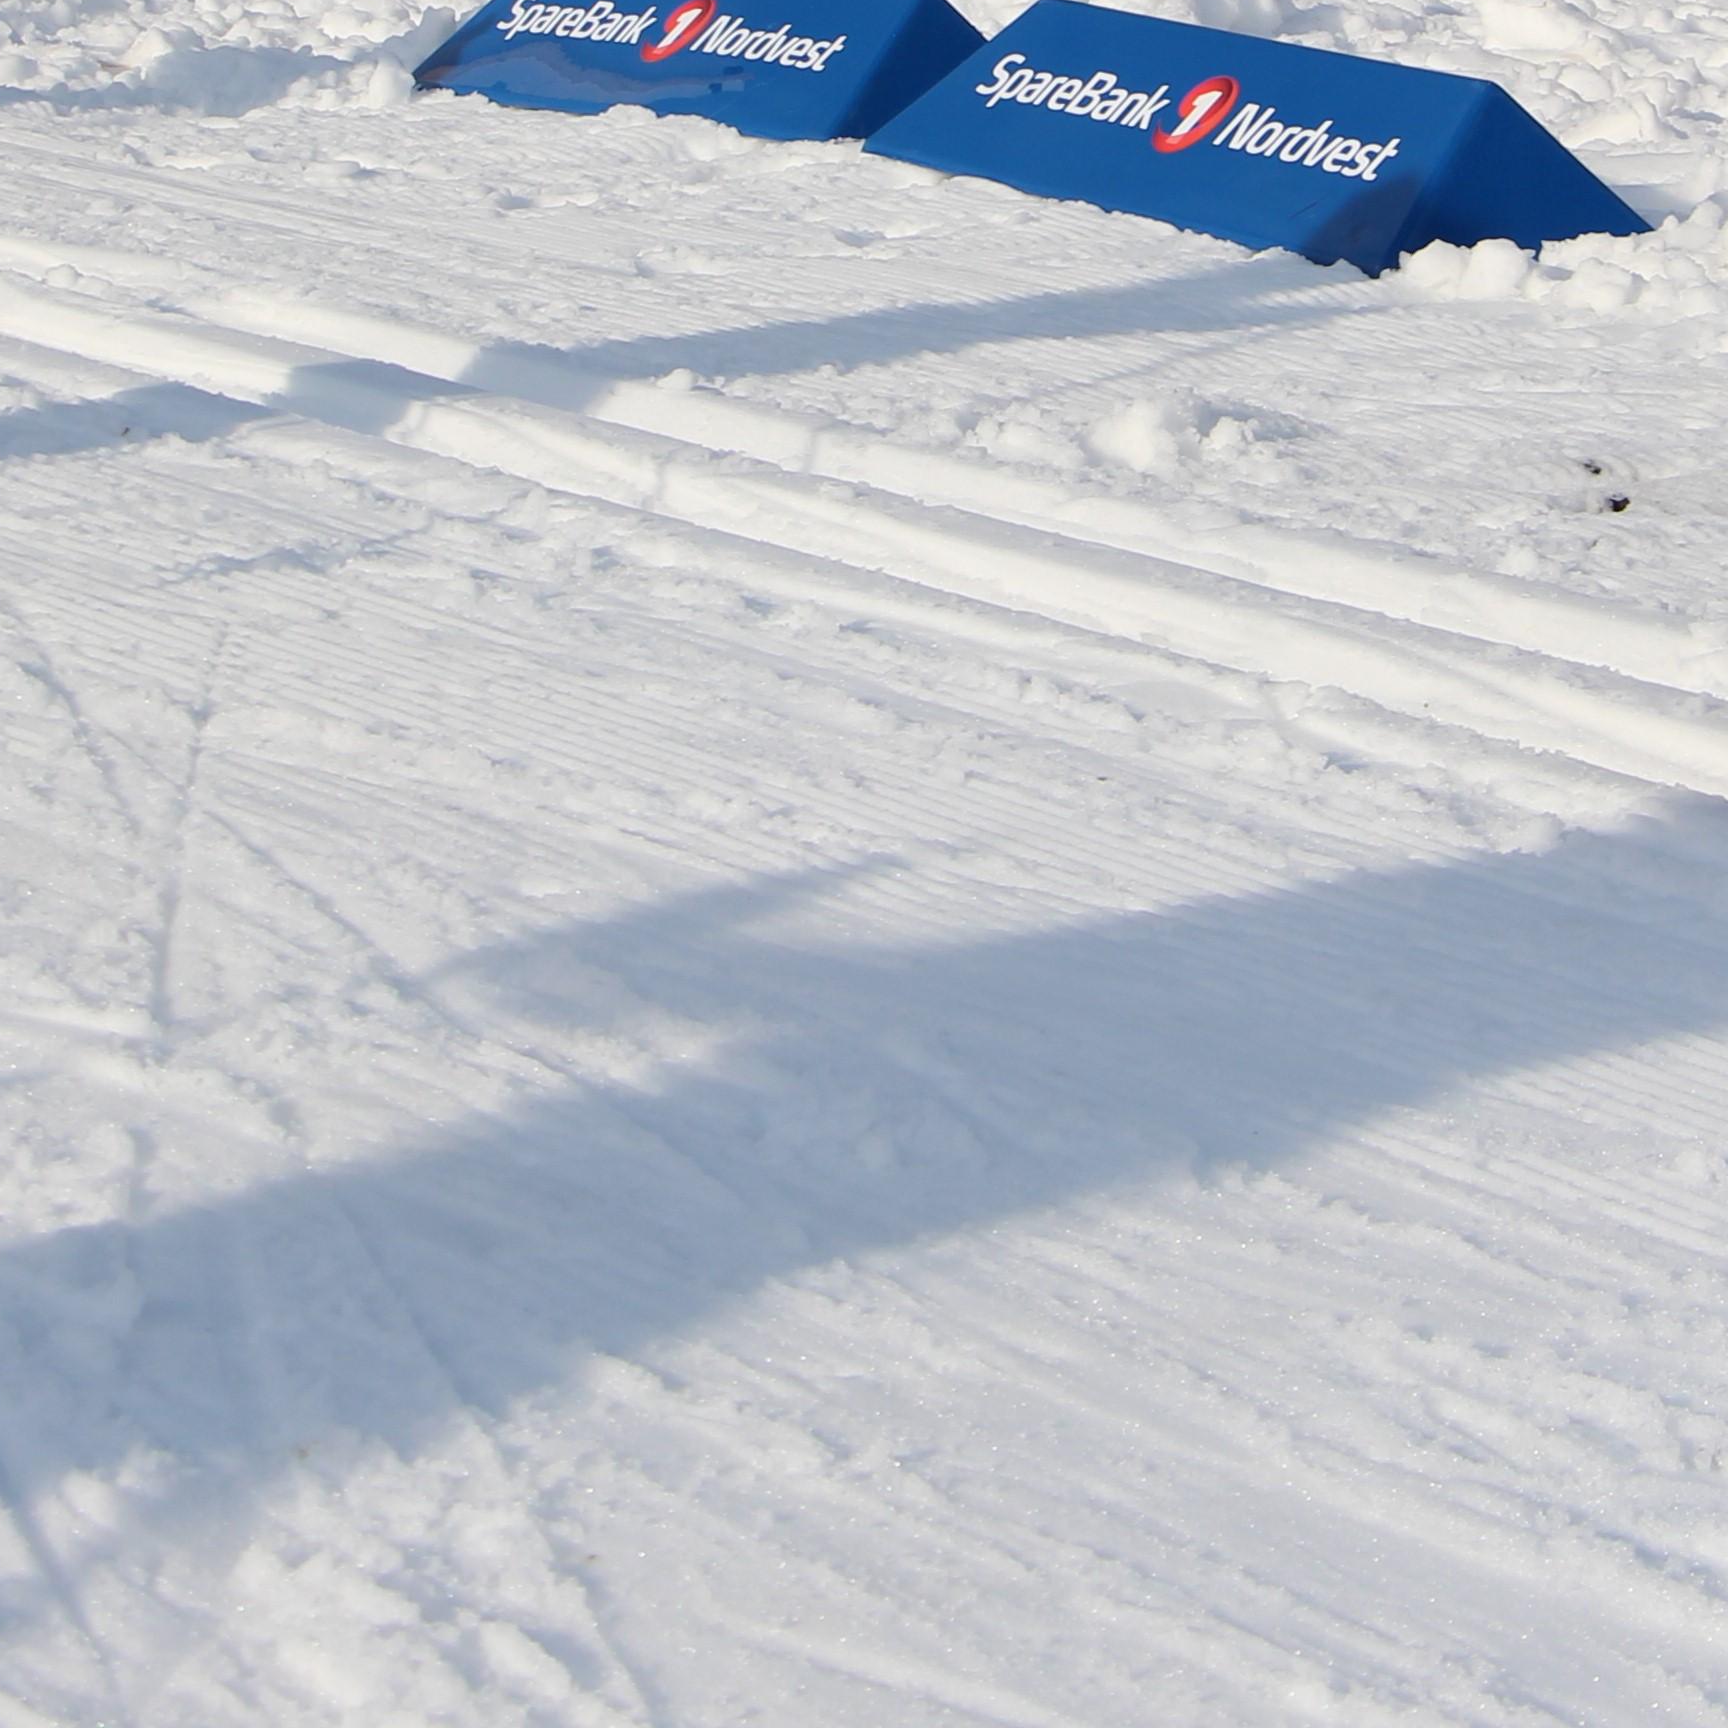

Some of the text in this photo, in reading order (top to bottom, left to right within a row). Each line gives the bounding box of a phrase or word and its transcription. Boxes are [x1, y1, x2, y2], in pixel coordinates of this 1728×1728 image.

[654, 7, 704, 52] 1
[689, 15, 848, 72] Nordvest
[975, 53, 1402, 182] SpareBank 1 Nordvest
